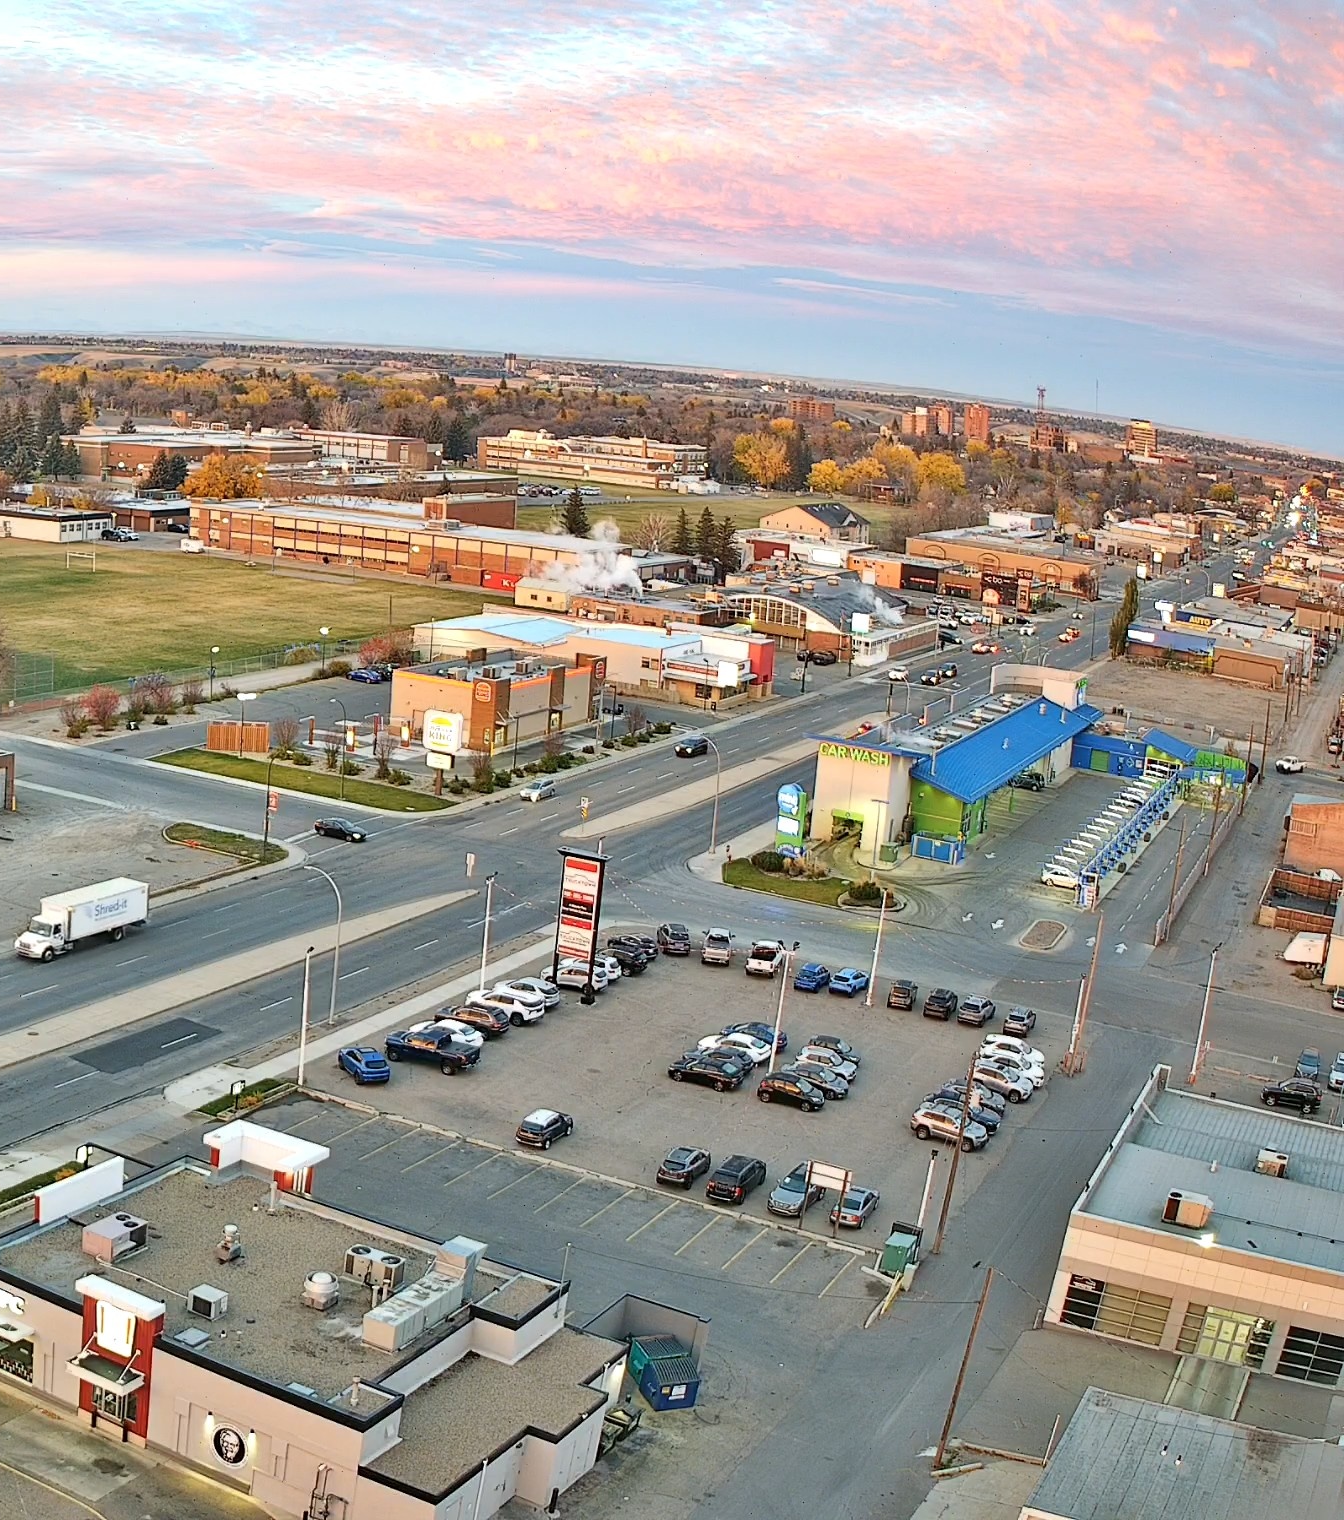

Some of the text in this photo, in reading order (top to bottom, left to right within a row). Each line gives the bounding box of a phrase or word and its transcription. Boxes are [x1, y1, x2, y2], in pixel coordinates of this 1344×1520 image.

[1189, 615, 1211, 626] AUTO
[819, 742, 890, 766] CAR WASH
[94, 898, 128, 917] Shred-it
